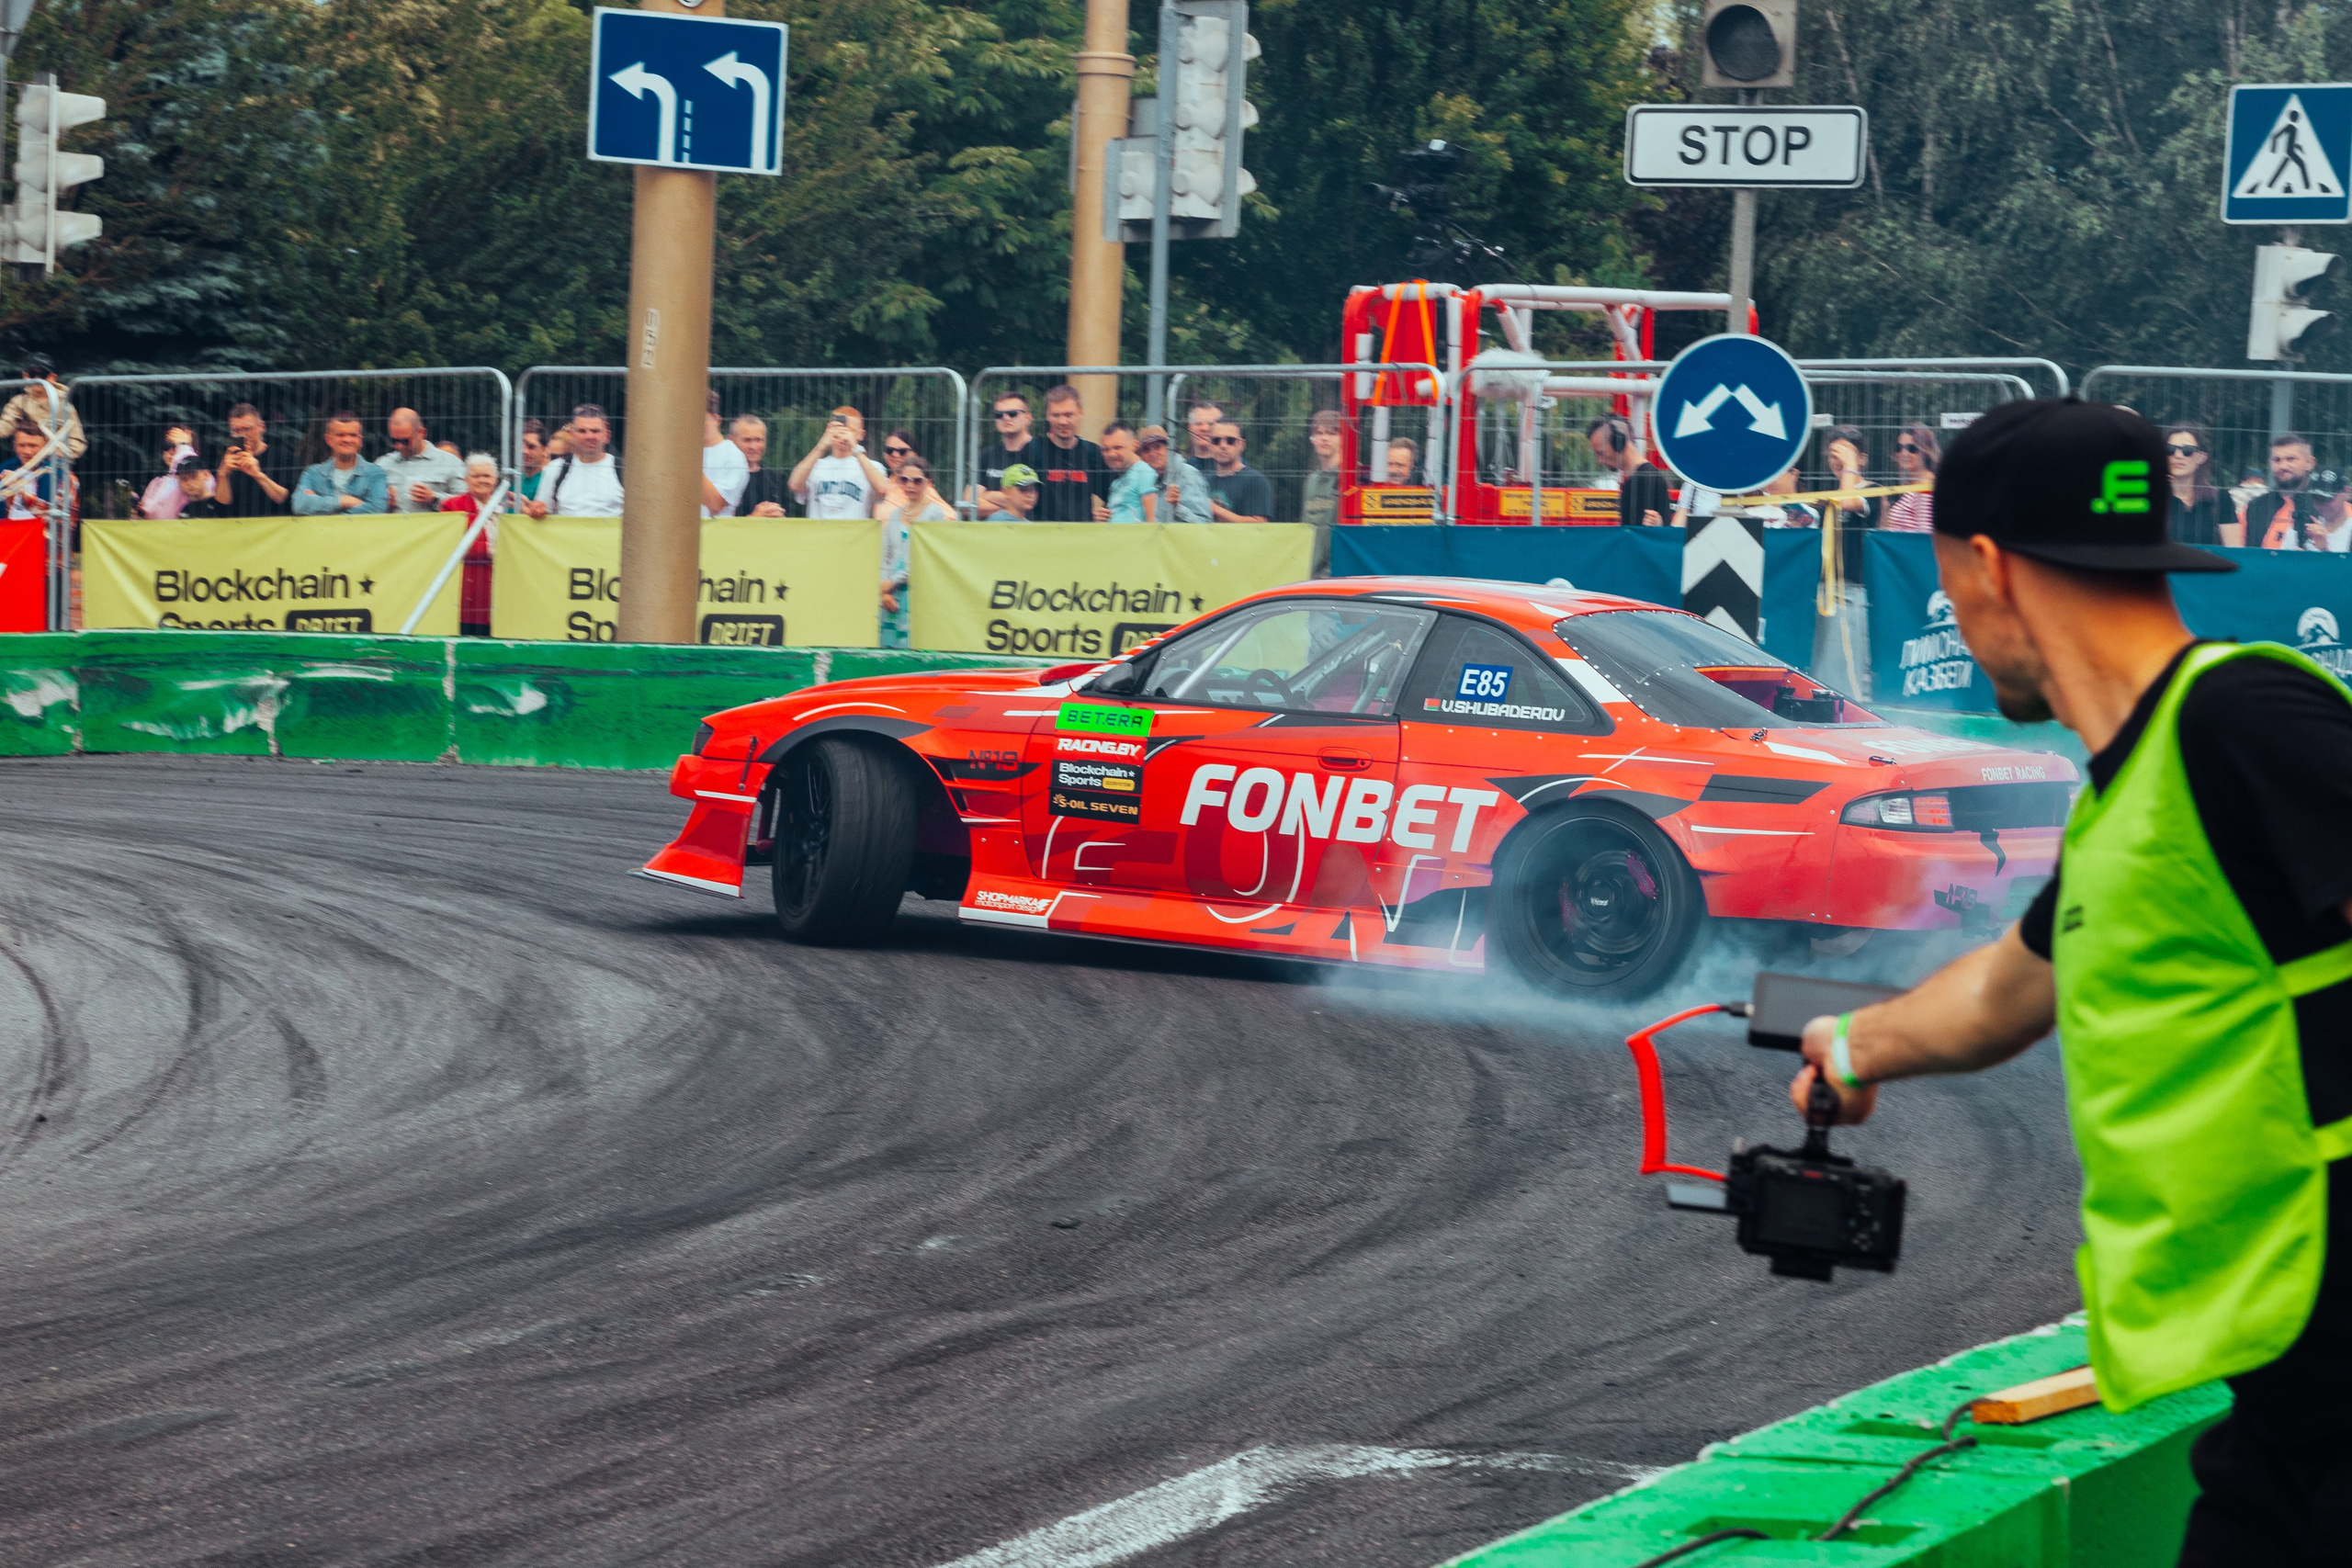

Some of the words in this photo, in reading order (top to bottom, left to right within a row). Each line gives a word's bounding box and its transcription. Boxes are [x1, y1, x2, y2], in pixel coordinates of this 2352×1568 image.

[1678, 125, 1813, 165] STOP
[155, 568, 350, 603] Blockchain
[989, 580, 1181, 614] Blockchain
[708, 621, 777, 646] DRIFT
[986, 619, 1102, 655] Sports
[1460, 669, 1508, 697] E85
[1441, 699, 1566, 721] V.SHUBADEROV
[1058, 762, 1128, 778] Blockchain
[1058, 773, 1102, 787] Sports
[1981, 767, 2013, 782] FONBET
[2016, 766, 2046, 781] RACING
[1090, 802, 1138, 815] SEVEN
[1180, 763, 1500, 854] FONBET
